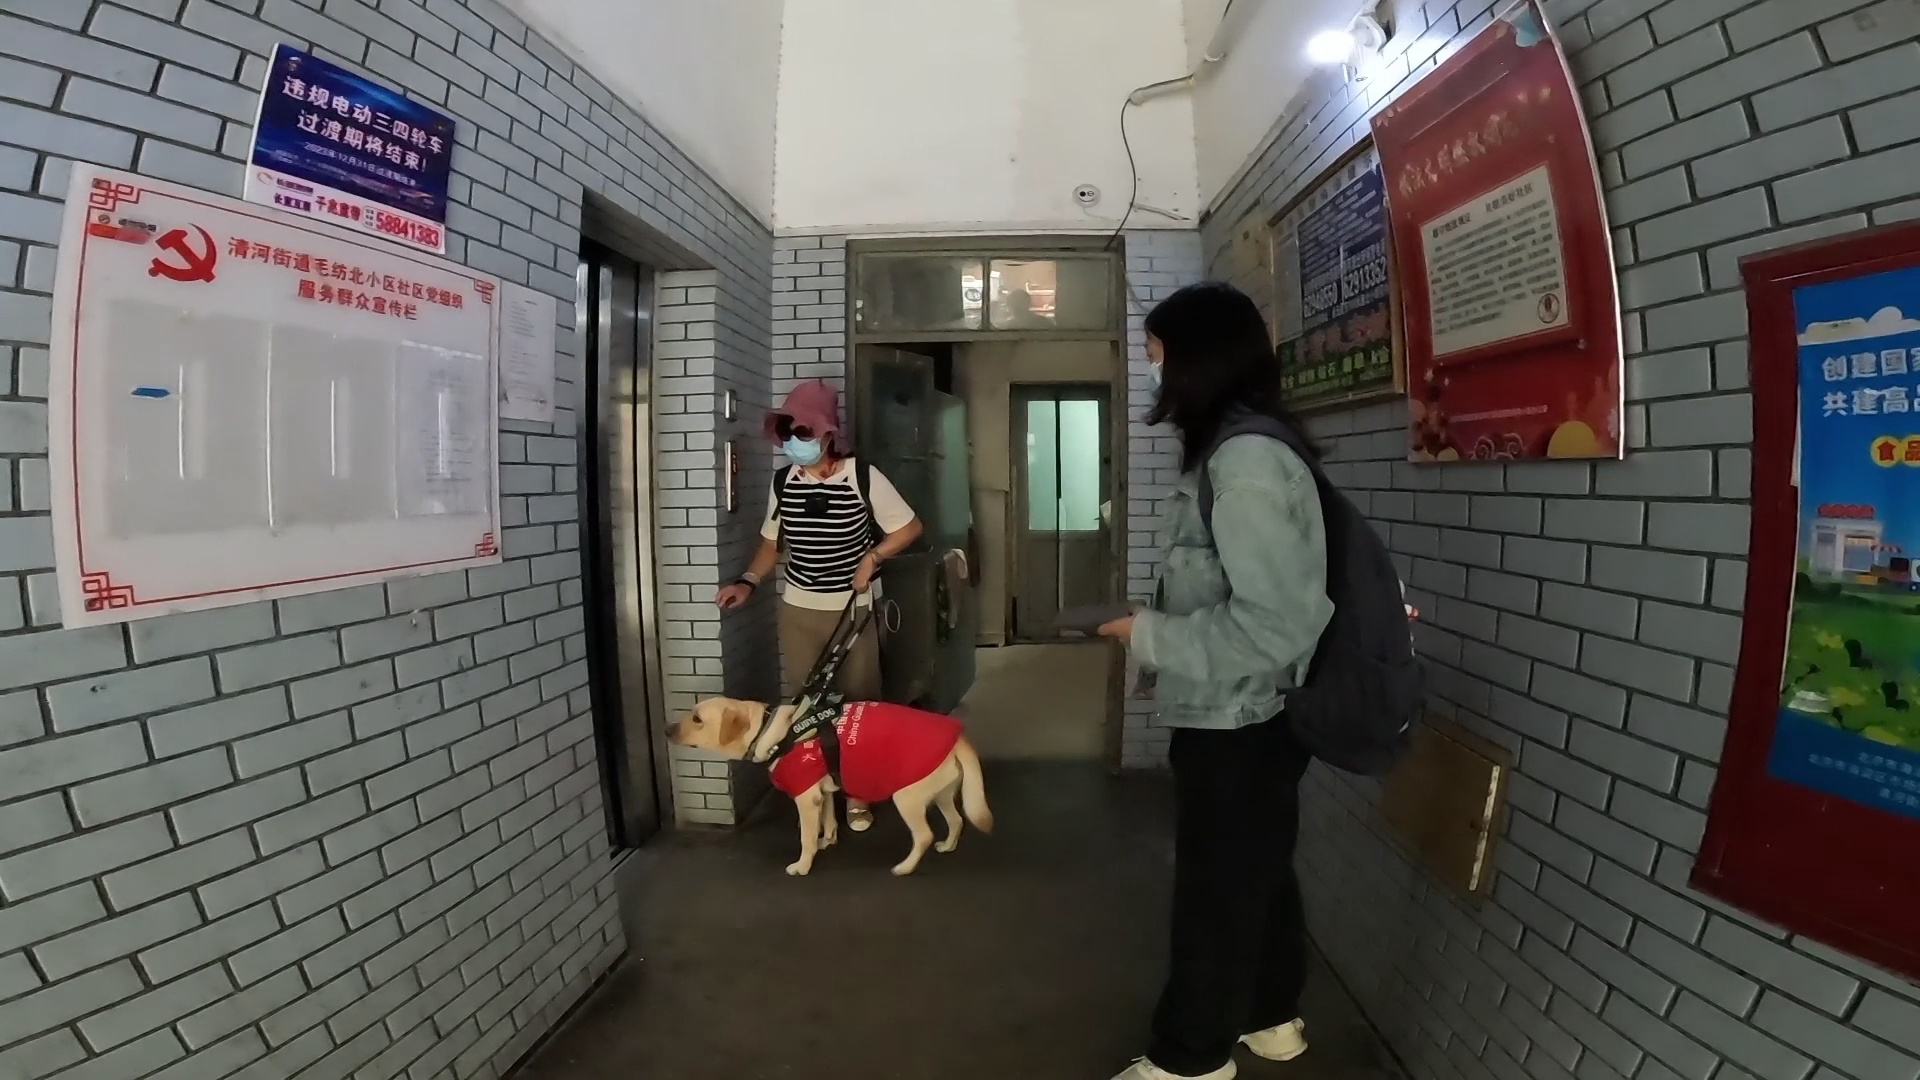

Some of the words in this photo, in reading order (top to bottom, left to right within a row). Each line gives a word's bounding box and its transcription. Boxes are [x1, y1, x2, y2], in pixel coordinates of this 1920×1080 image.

[282, 76, 443, 154] 违规电动三四轮车
[227, 236, 463, 310] 清河街道毛纺北小区社区党组织
[297, 279, 418, 321] 服务群众宣传栏
[793, 714, 818, 734] GUIDE
[817, 707, 836, 720] DOG
